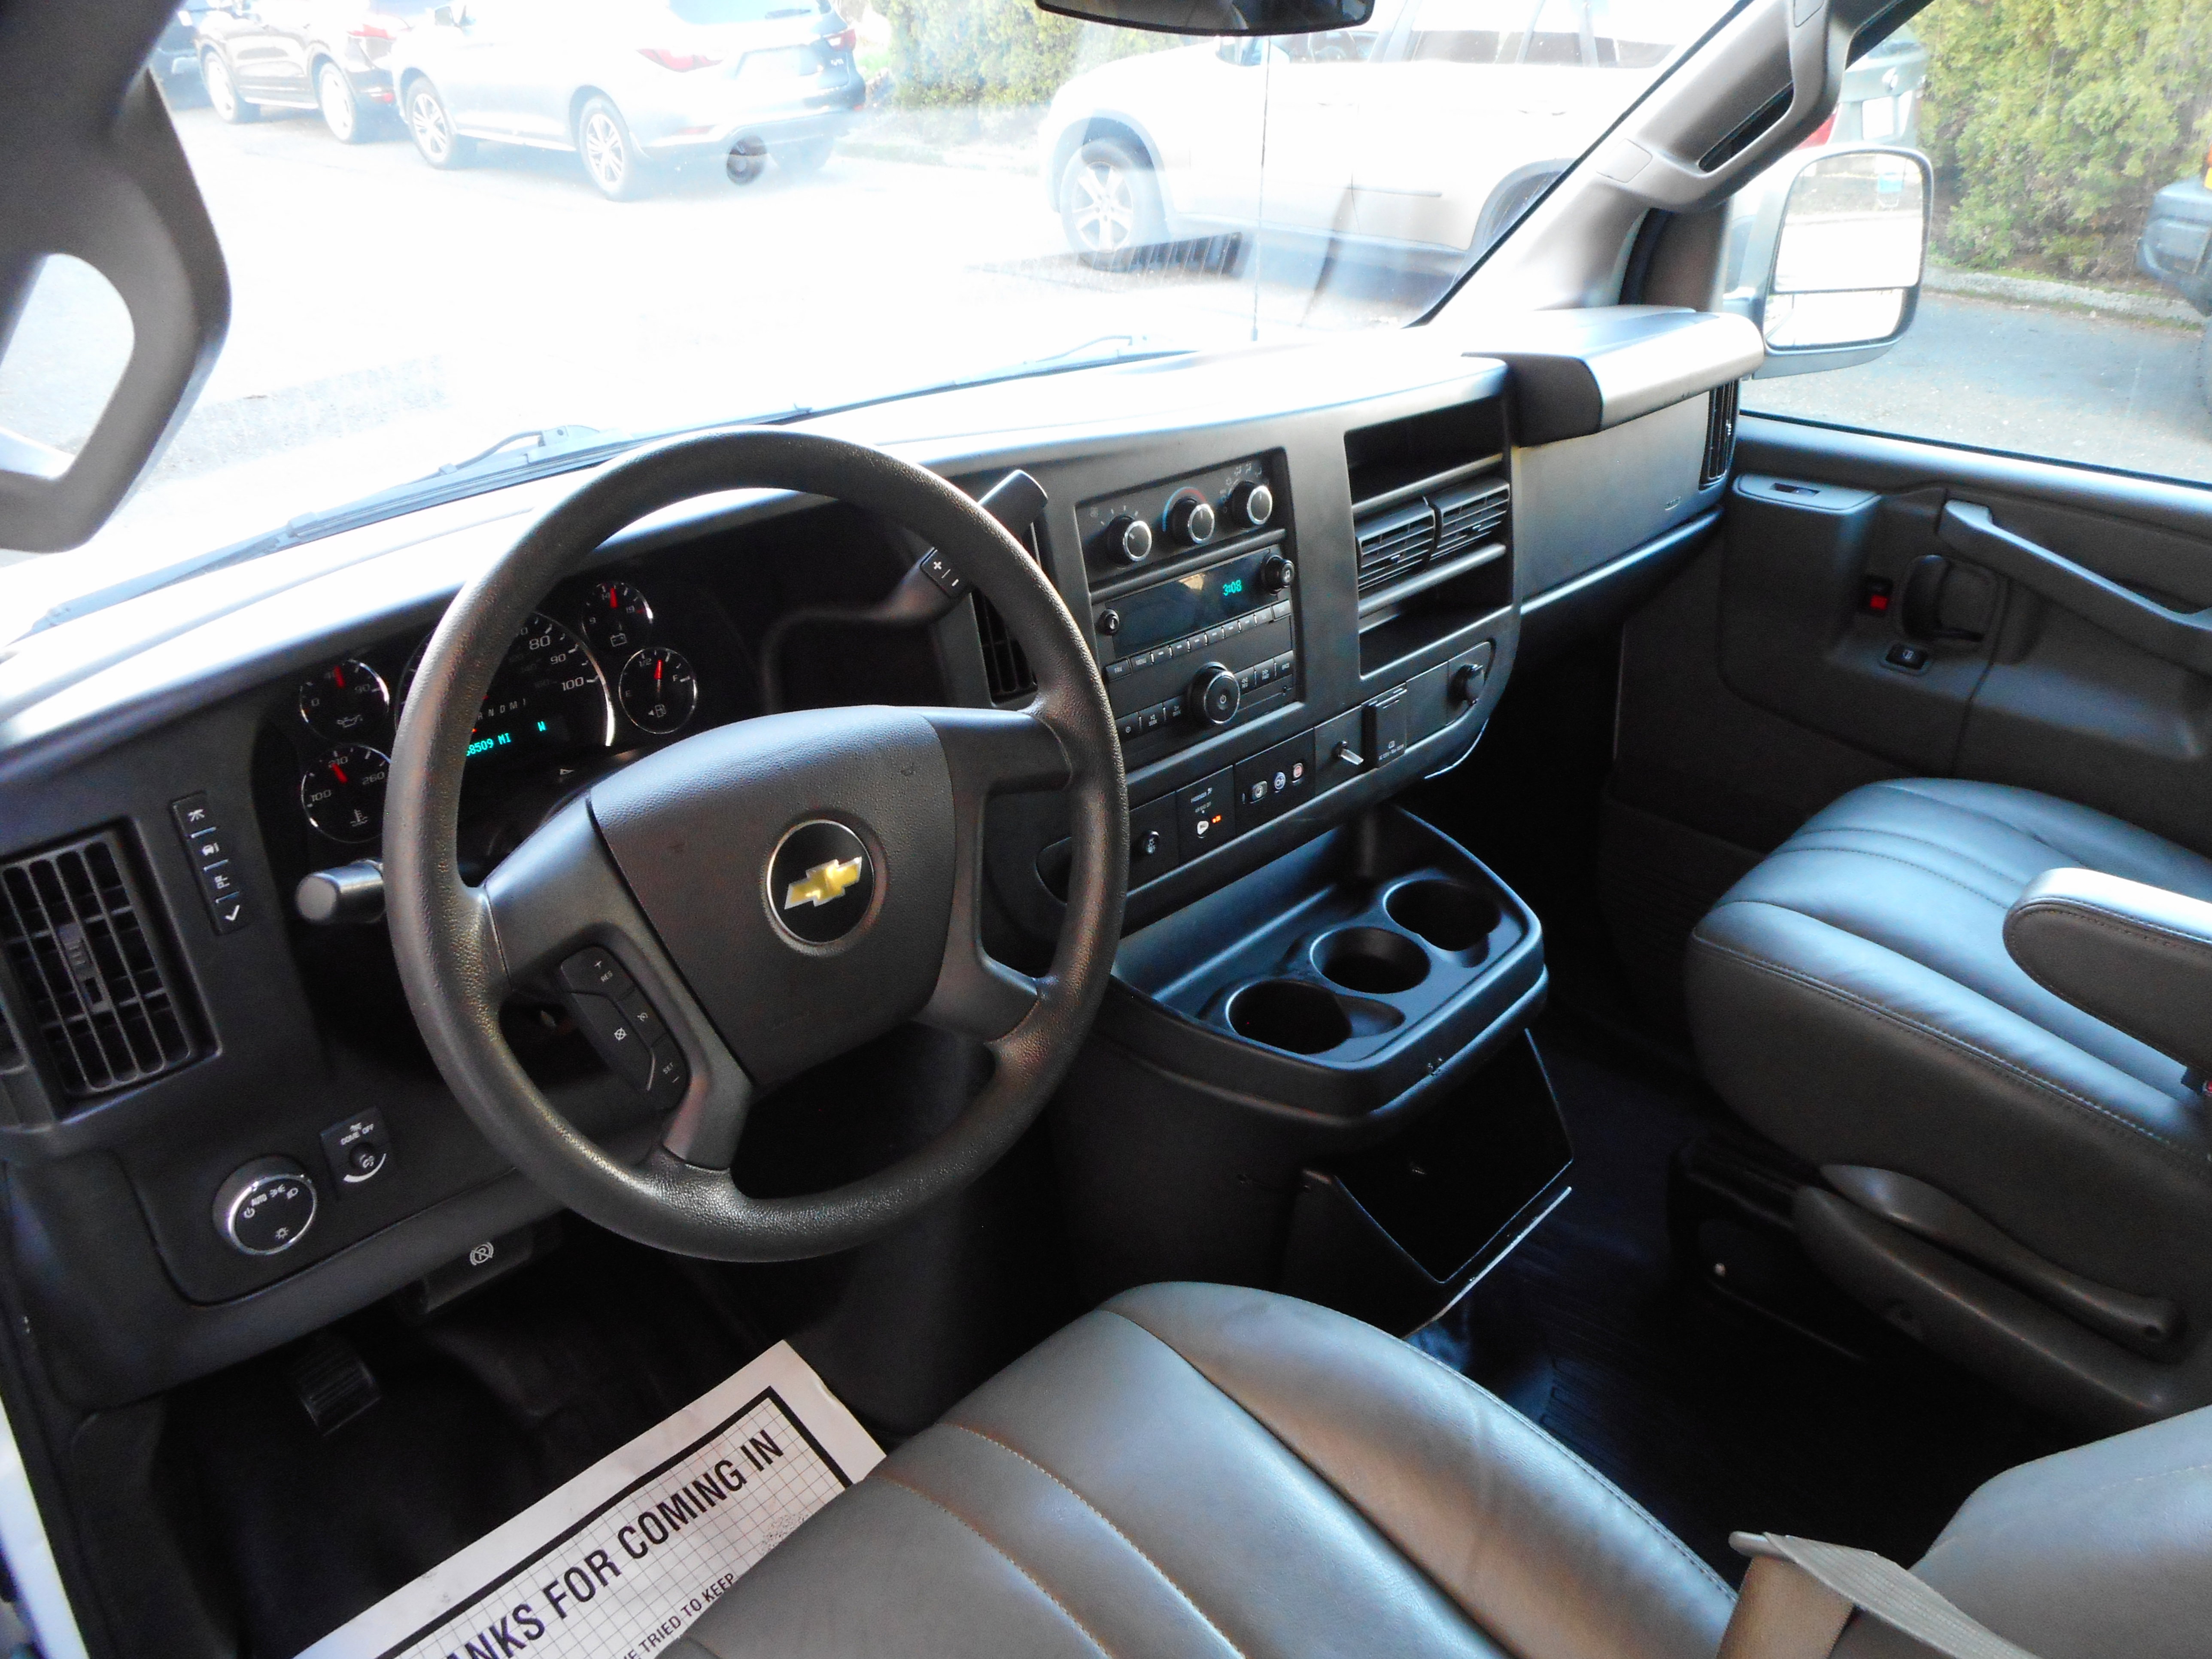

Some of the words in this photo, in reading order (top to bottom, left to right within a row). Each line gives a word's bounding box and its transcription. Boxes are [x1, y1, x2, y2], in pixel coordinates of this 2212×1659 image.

[1223, 580, 1242, 596] 3:08
[529, 635, 551, 650] 80
[550, 653, 566, 665] 90
[562, 677, 584, 691] 100
[498, 732, 512, 745] MI
[362, 772, 385, 785] 260
[310, 789, 332, 802] 100
[601, 970, 613, 982] RES
[662, 1062, 674, 1074] SET
[340, 1131, 360, 1145] DOME
[362, 1123, 374, 1134] OFF
[251, 1193, 268, 1207] AUTO
[447, 1603, 545, 1659] NKS
[543, 1549, 622, 1620] FOR
[617, 1459, 747, 1559] COMING
[740, 1430, 784, 1472] IN
[638, 1615, 682, 1653] TRIED
[681, 1598, 702, 1618] TO
[702, 1573, 734, 1603] KEEP
